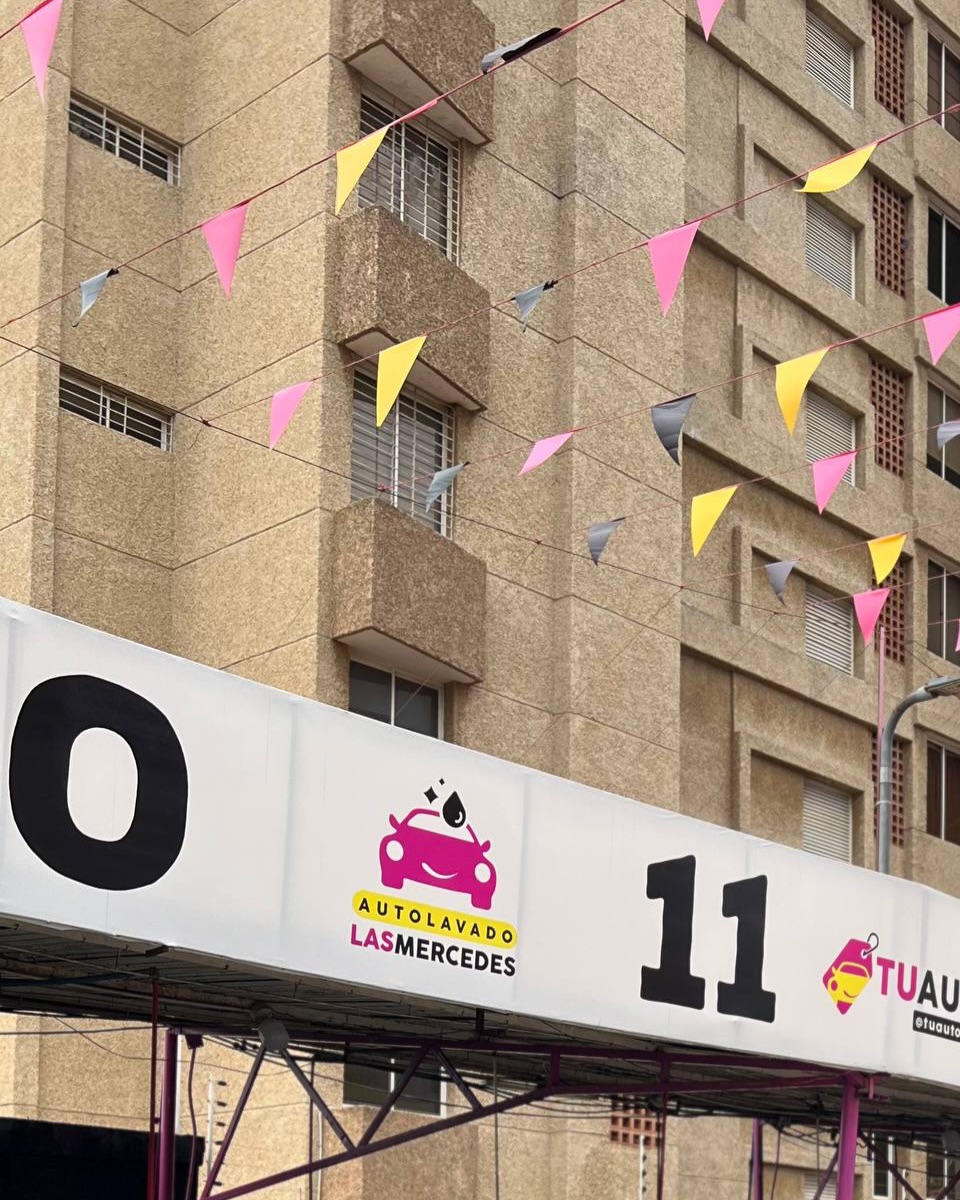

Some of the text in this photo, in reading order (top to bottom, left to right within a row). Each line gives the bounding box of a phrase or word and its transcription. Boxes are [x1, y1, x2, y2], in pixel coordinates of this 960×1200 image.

[359, 898, 513, 944] AUTOLAVADO
[640, 854, 777, 1023] 11
[350, 923, 516, 977] LASMERCEDES
